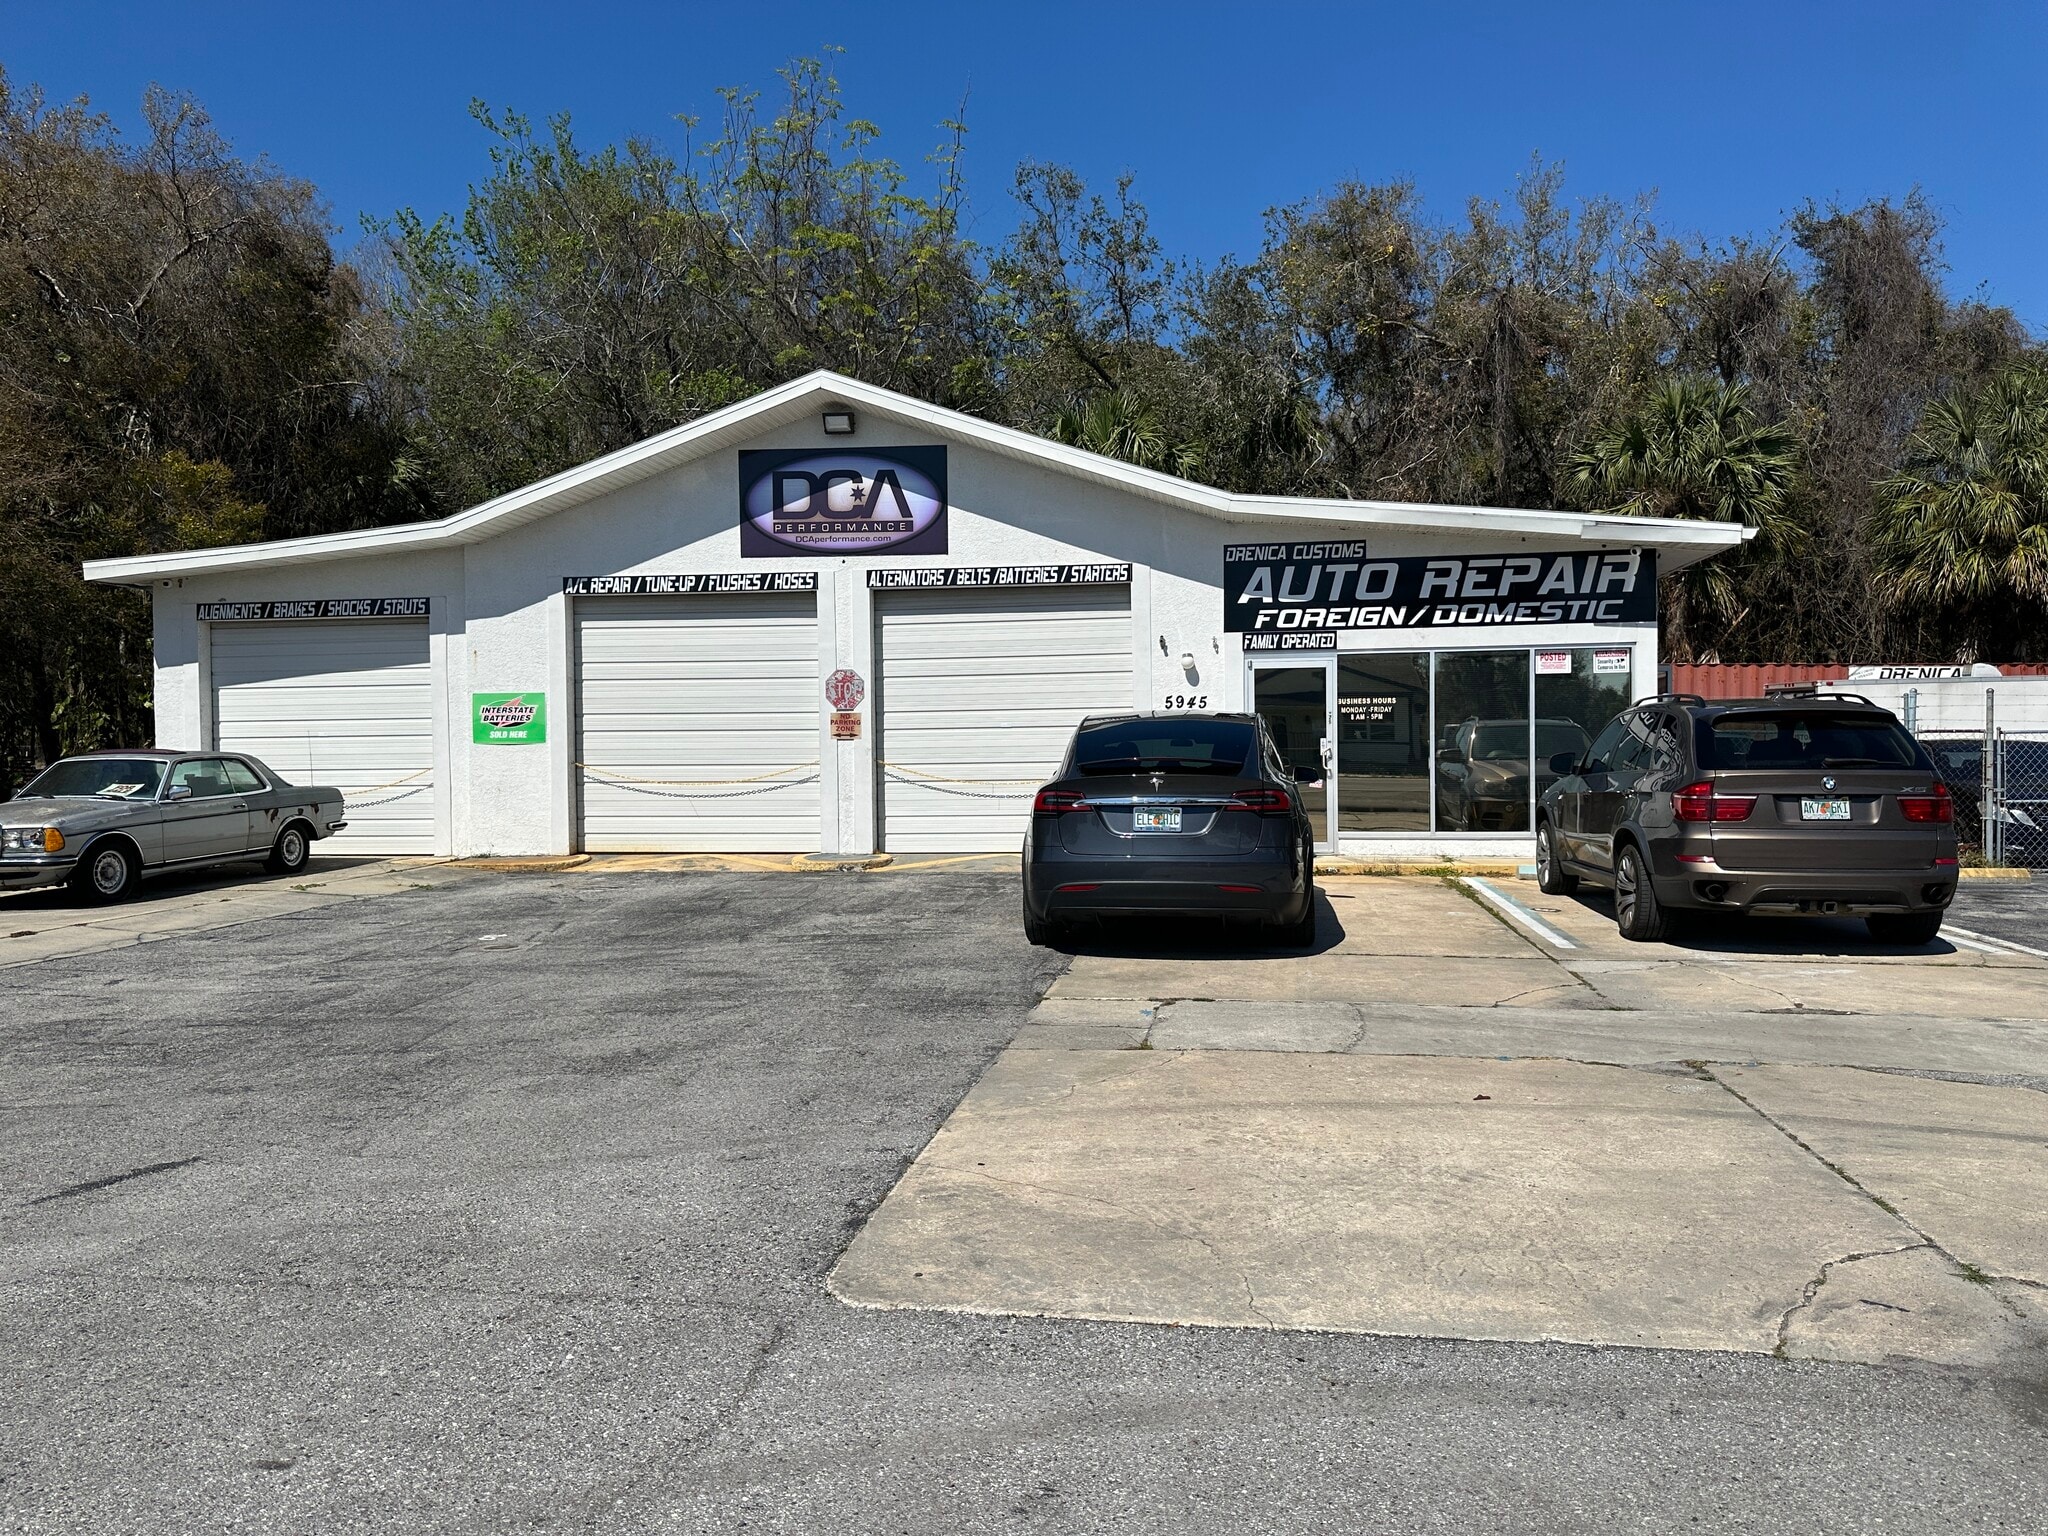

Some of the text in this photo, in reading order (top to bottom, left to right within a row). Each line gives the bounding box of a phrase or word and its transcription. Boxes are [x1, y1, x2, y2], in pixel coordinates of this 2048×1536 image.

[772, 469, 914, 520] DCA
[774, 522, 907, 532] PERFORMANCE
[795, 535, 891, 543] DCAperformance.com
[1225, 543, 1365, 562] DRENICA CUSTOMS
[564, 577, 588, 594] A/C
[590, 577, 631, 593] REPAIR
[645, 575, 696, 592] TUNE-UP
[708, 574, 762, 591] FLUSHES
[774, 573, 815, 590] HOSES
[868, 569, 944, 587] ALTERNATORS
[956, 568, 991, 585] BELTS
[1070, 564, 1128, 582] STARTERS
[1237, 554, 1641, 604] AUTO REPAIR
[197, 603, 262, 620] ALIGNMENTS
[273, 602, 316, 618] BRAKES
[327, 600, 371, 616] SHOCKS
[383, 598, 427, 615] STRUTS
[1254, 606, 1408, 629] FOREIGN
[1431, 599, 1624, 625] DOMESTIC
[1243, 632, 1336, 650] FAMILY OPERATED
[1540, 652, 1567, 662] POSTED
[826, 681, 864, 700] STOP
[481, 706, 535, 714] INTERSTATE
[1165, 695, 1208, 709] 5945
[483, 714, 531, 722] BATTERIES
[489, 730, 528, 739] SOLD HERE
